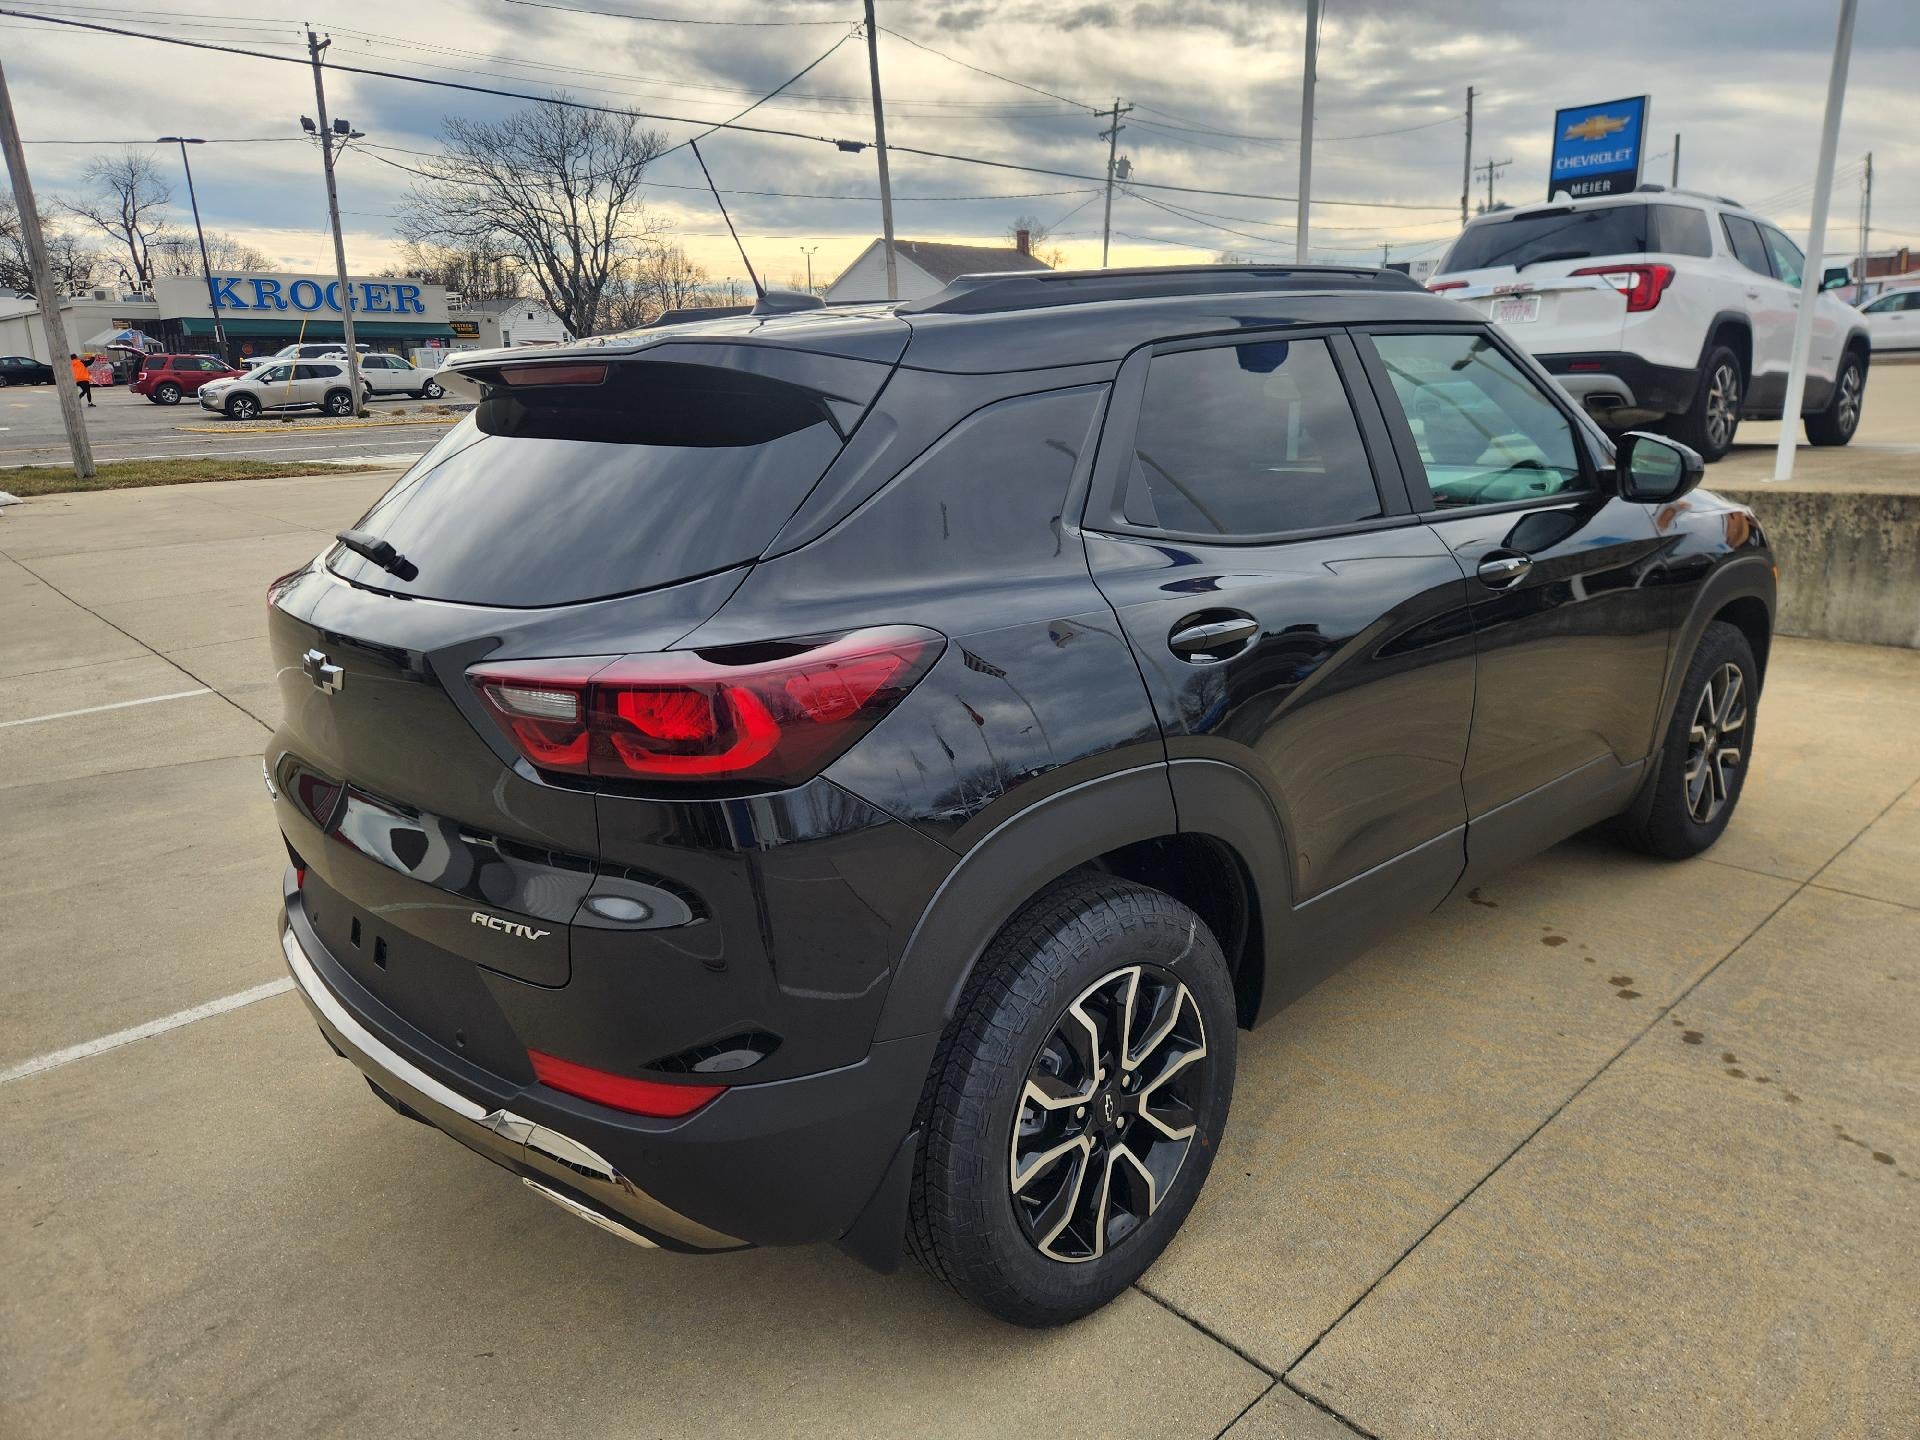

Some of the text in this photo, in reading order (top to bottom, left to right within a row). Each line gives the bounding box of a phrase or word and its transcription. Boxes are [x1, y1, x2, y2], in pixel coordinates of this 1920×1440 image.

[1556, 147, 1632, 170] CHEVROLET
[1571, 180, 1612, 196] MEIER
[207, 277, 425, 314] KROGER
[1493, 283, 1534, 294] GMC
[471, 911, 551, 940] ACTIV
